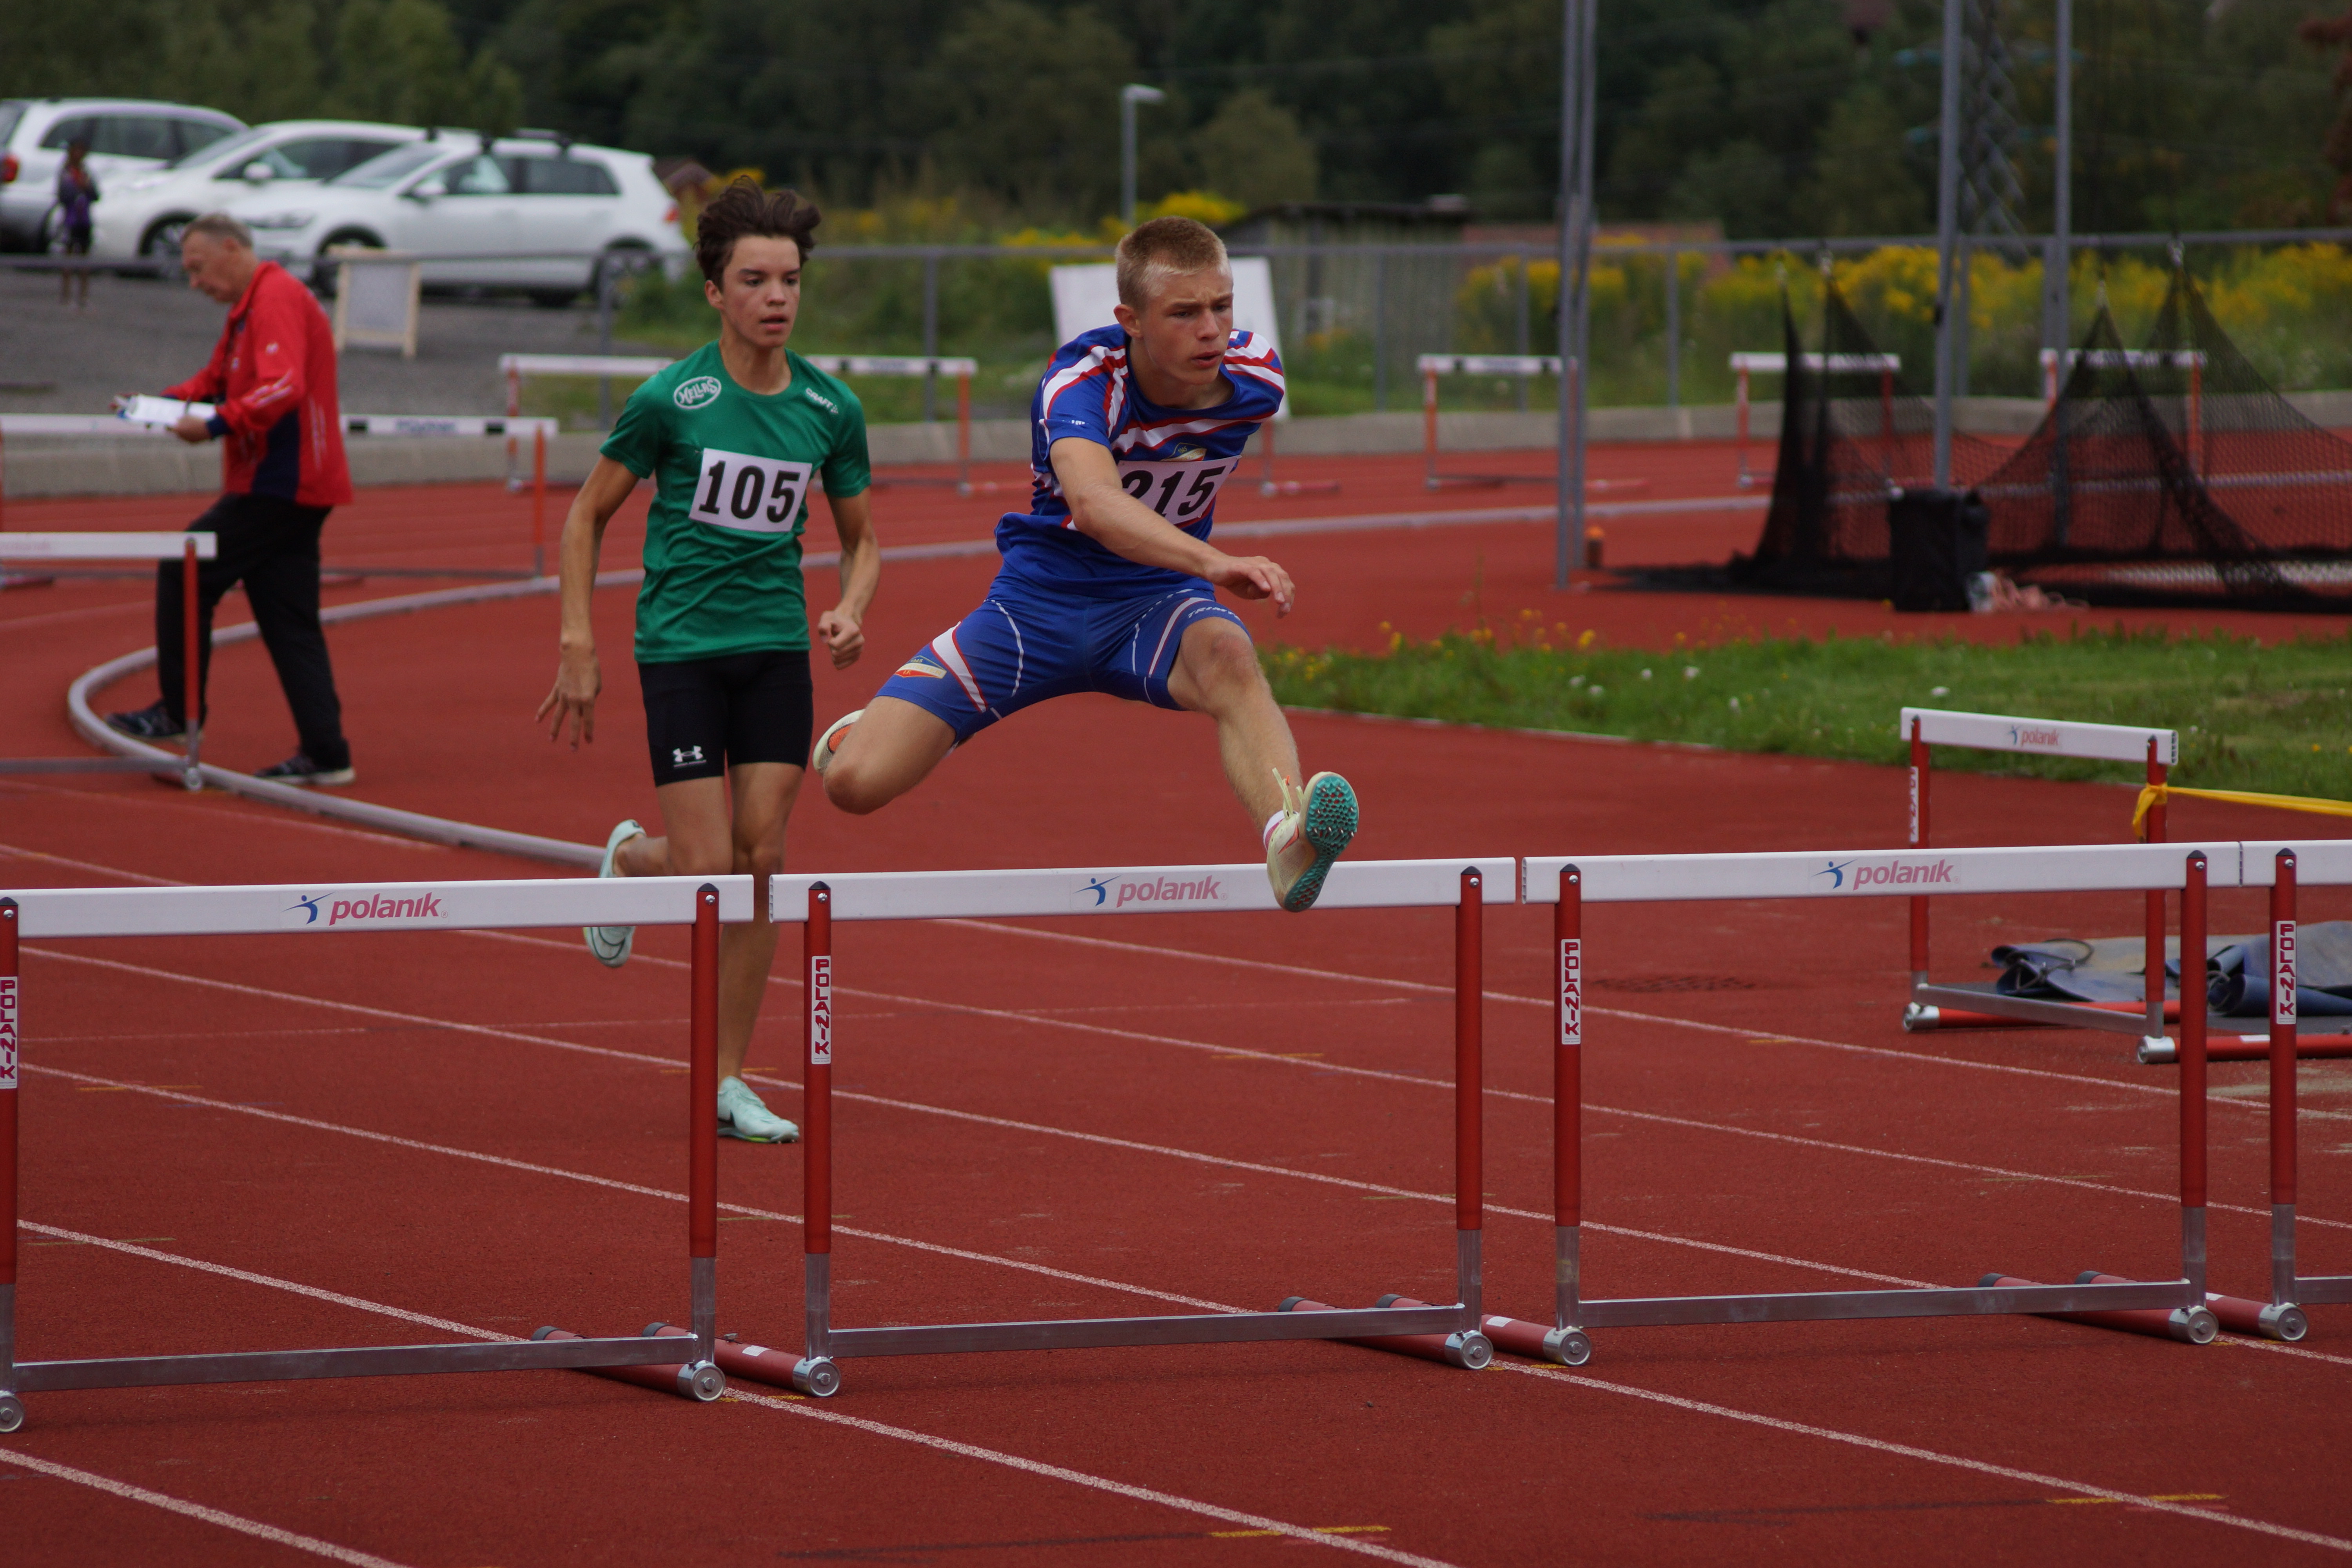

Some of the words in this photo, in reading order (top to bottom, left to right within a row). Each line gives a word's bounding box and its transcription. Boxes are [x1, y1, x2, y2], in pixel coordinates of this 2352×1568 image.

[678, 379, 718, 404] HELLAS
[806, 387, 833, 408] CRAFT
[698, 460, 800, 523] 105
[1122, 465, 1226, 517] 215
[1188, 607, 1243, 622] TRIMT
[2021, 726, 2060, 746] polanik
[1116, 875, 1221, 908] polanik
[1853, 858, 1954, 891] polanik
[328, 892, 442, 926] polanik
[2278, 924, 2296, 1015] POLANIK
[1563, 942, 1580, 1035] POLANIK
[813, 959, 830, 1054] POLANIK
[0, 980, 16, 1079] POLANIK
